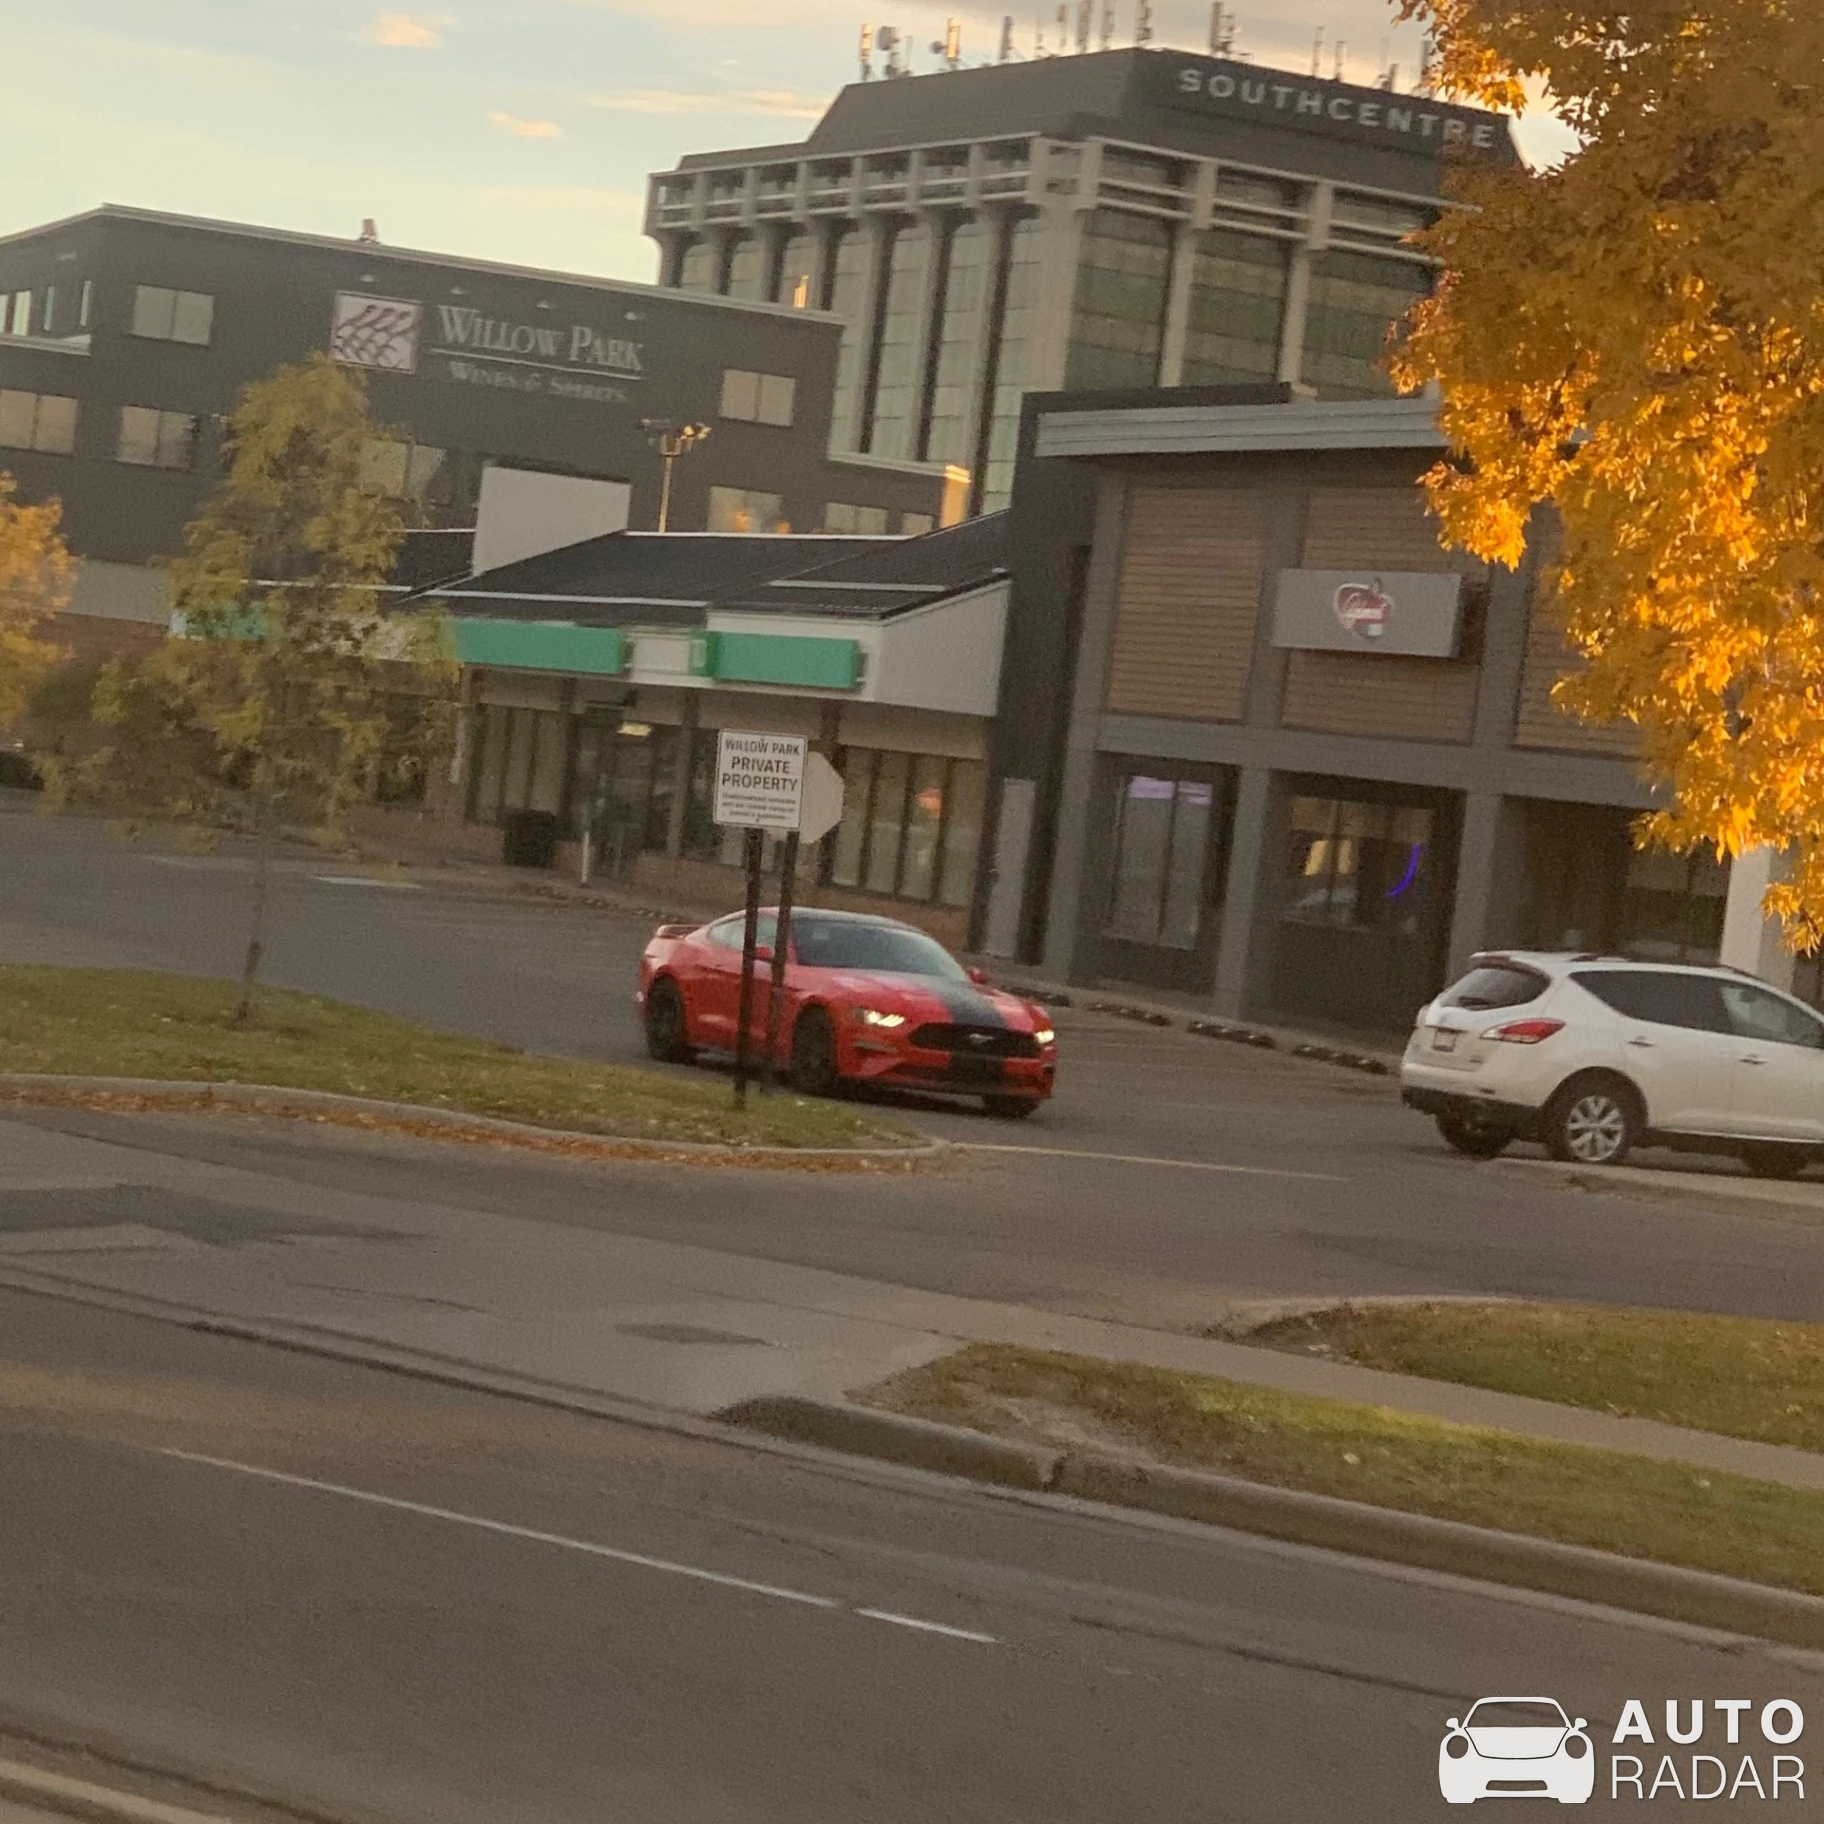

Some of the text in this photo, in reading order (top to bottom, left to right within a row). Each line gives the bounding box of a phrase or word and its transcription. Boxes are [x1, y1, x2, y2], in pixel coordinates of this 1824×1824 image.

[1179, 67, 1495, 149] SOUTHCENTRE
[437, 303, 643, 371] WILLOW PARK
[725, 739, 800, 757] WILLOW PARK
[731, 756, 790, 775] PRIVATE
[722, 773, 798, 792] PROPERTY
